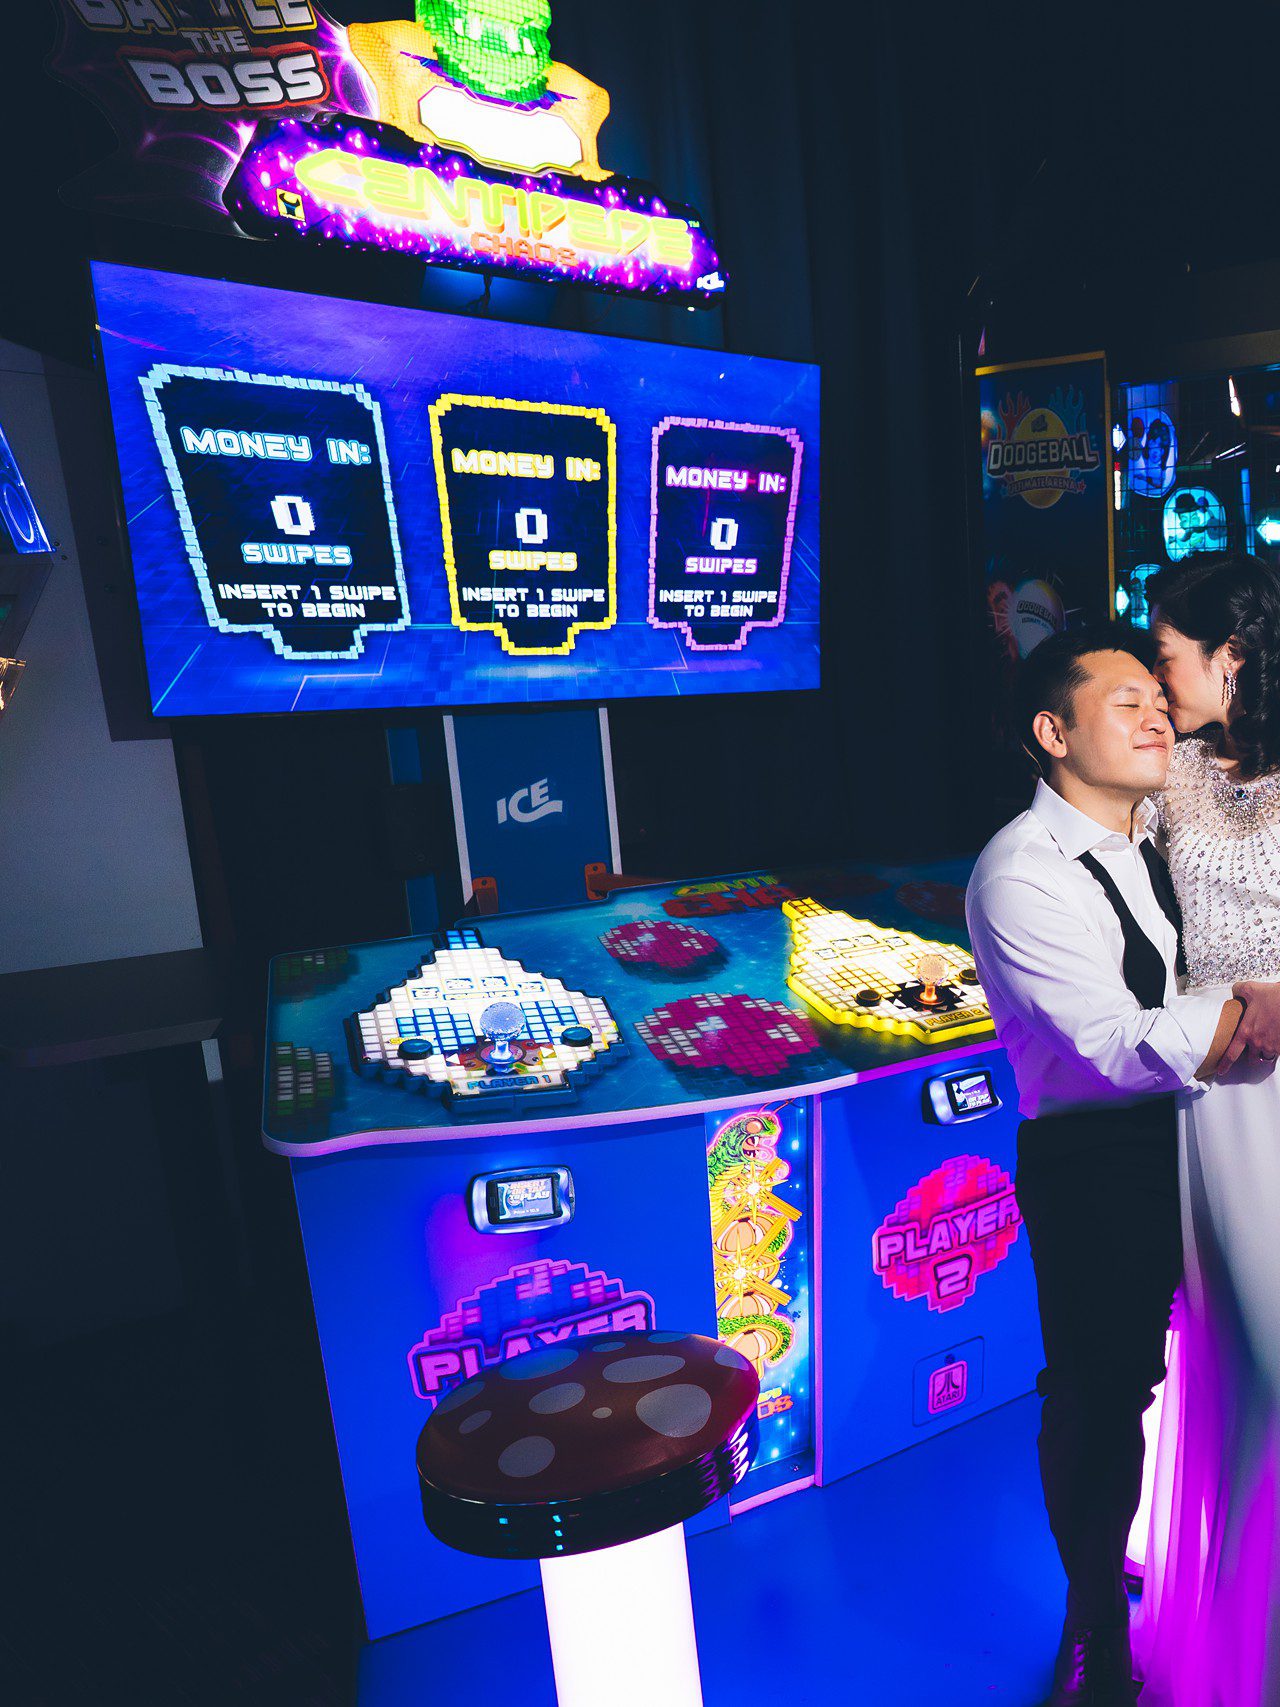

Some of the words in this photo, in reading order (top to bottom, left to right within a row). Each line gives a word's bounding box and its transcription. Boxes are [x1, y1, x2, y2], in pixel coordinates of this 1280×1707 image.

[72, 0, 313, 30] BALE
[181, 30, 250, 53] THE
[127, 53, 324, 105] BOSS
[295, 148, 693, 267] CENTIPEDE
[470, 232, 580, 266] CHAOS
[181, 427, 312, 461] MONEY
[327, 438, 371, 465] IN:
[989, 436, 1097, 471] DODGEBALL
[452, 449, 554, 479] MONEY
[566, 456, 601, 481] IN:
[666, 465, 748, 491] MONEY
[758, 471, 786, 493] IN:
[270, 495, 315, 536] 0
[515, 507, 548, 544] 0
[710, 517, 739, 550] 0
[241, 542, 352, 567] SWIPES
[489, 550, 577, 572] SWIPES
[685, 556, 758, 575] SWIPES
[218, 583, 301, 600] INSERT
[311, 584, 321, 600] 1
[329, 585, 396, 601] SWIPE
[463, 587, 529, 603] INSERT
[536, 588, 544, 602] 1
[551, 588, 606, 604] SWIPE
[659, 589, 715, 603] INSERT
[720, 590, 726, 603] 1
[731, 590, 778, 604] SWIPE
[262, 602, 293, 618] TO
[302, 602, 366, 618] BEGIN
[495, 604, 520, 618] TO
[527, 604, 578, 618] BEGIN
[684, 604, 705, 617] TO
[710, 604, 754, 618] BEGIN
[496, 777, 563, 824] ICE
[925, 1011, 972, 1027] PLAYER
[466, 1076, 539, 1090] PLAYER
[542, 1075, 551, 1084] 1
[879, 1194, 1021, 1267] PLAYER
[935, 1255, 972, 1298] 2
[935, 1390, 960, 1406] ATARI
